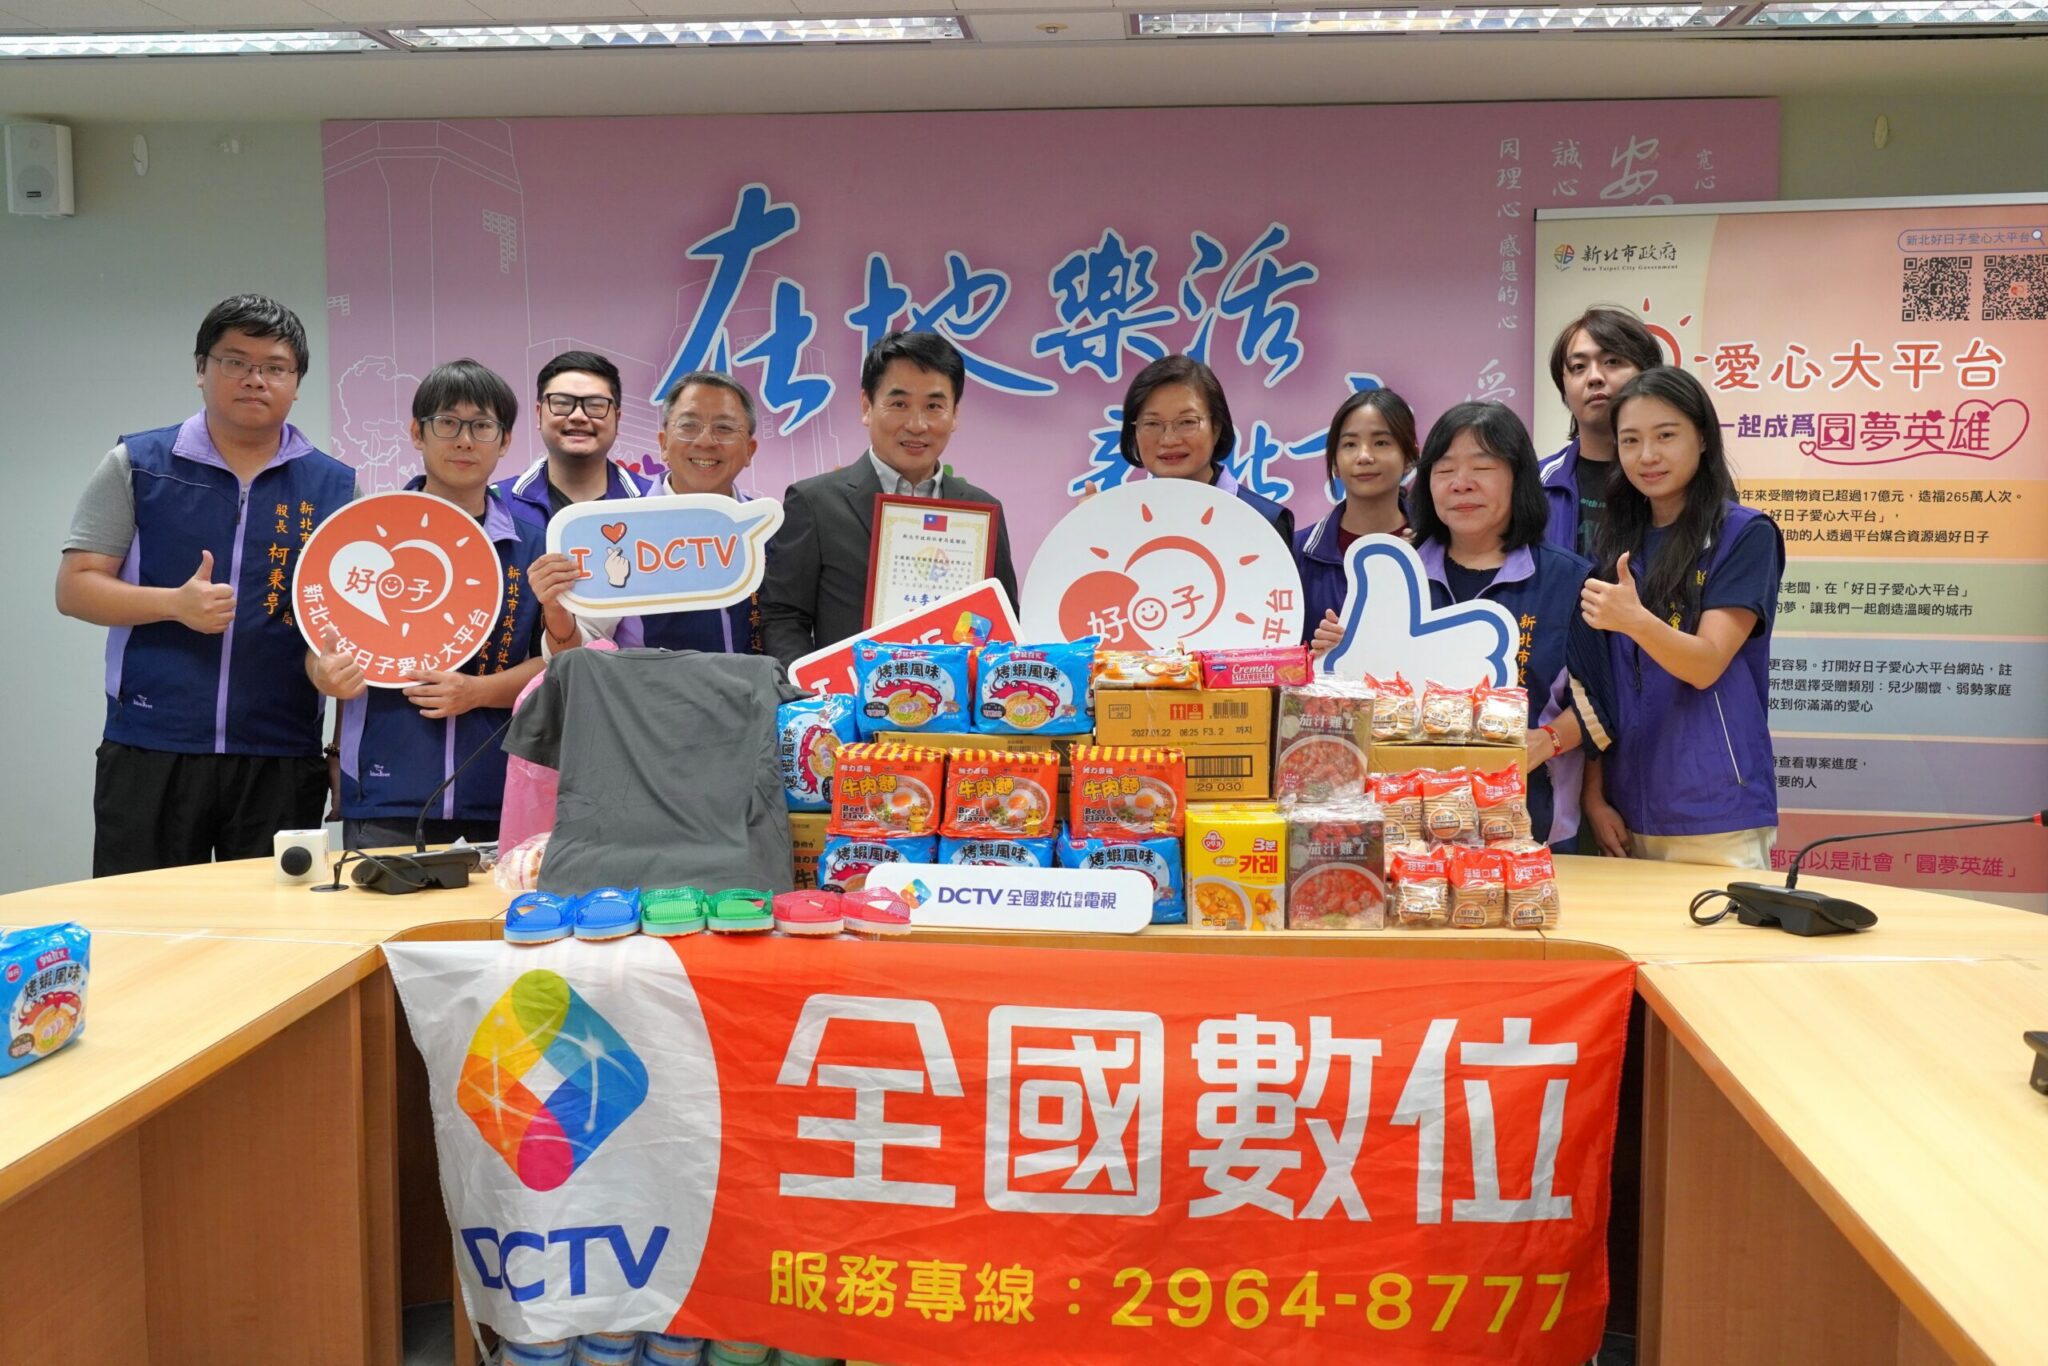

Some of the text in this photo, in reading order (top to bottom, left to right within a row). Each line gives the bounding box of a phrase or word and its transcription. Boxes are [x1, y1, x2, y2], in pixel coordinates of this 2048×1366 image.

[1552, 140, 1582, 196] 誠心
[1694, 149, 1717, 191] 寬心
[1906, 232, 2030, 246] 新北好日子愛心大平台
[1581, 242, 1677, 264] 新北市政府
[652, 183, 1318, 434] 在地樂活
[1714, 338, 2005, 391] 愛心大平台
[1780, 529, 1989, 543] 助的人透過平台媒合資源過好日子
[263, 504, 290, 615] 股長 柯秉亨
[570, 535, 738, 578] I DCTV
[878, 662, 941, 681] 烤蝦風味
[995, 663, 1059, 681] 烤蝦風味
[1769, 698, 1873, 713] 收到你滿滿的愛心
[1131, 729, 1171, 738] 2027.01.22
[1196, 783, 1242, 793] 29 030
[1775, 775, 1817, 789] 要的人
[836, 844, 900, 863] 烤蝦風味
[961, 843, 1027, 861] 烤蝦風味
[1090, 848, 1154, 869] 烤蝦風味
[1239, 855, 1278, 874] 카레
[938, 887, 1003, 904] DCTV
[24, 963, 81, 1001] 烤蝦風味
[777, 993, 1578, 1224] 全國數位
[461, 1226, 670, 1301] DCTV
[1111, 1268, 1571, 1334] 2964-8777
